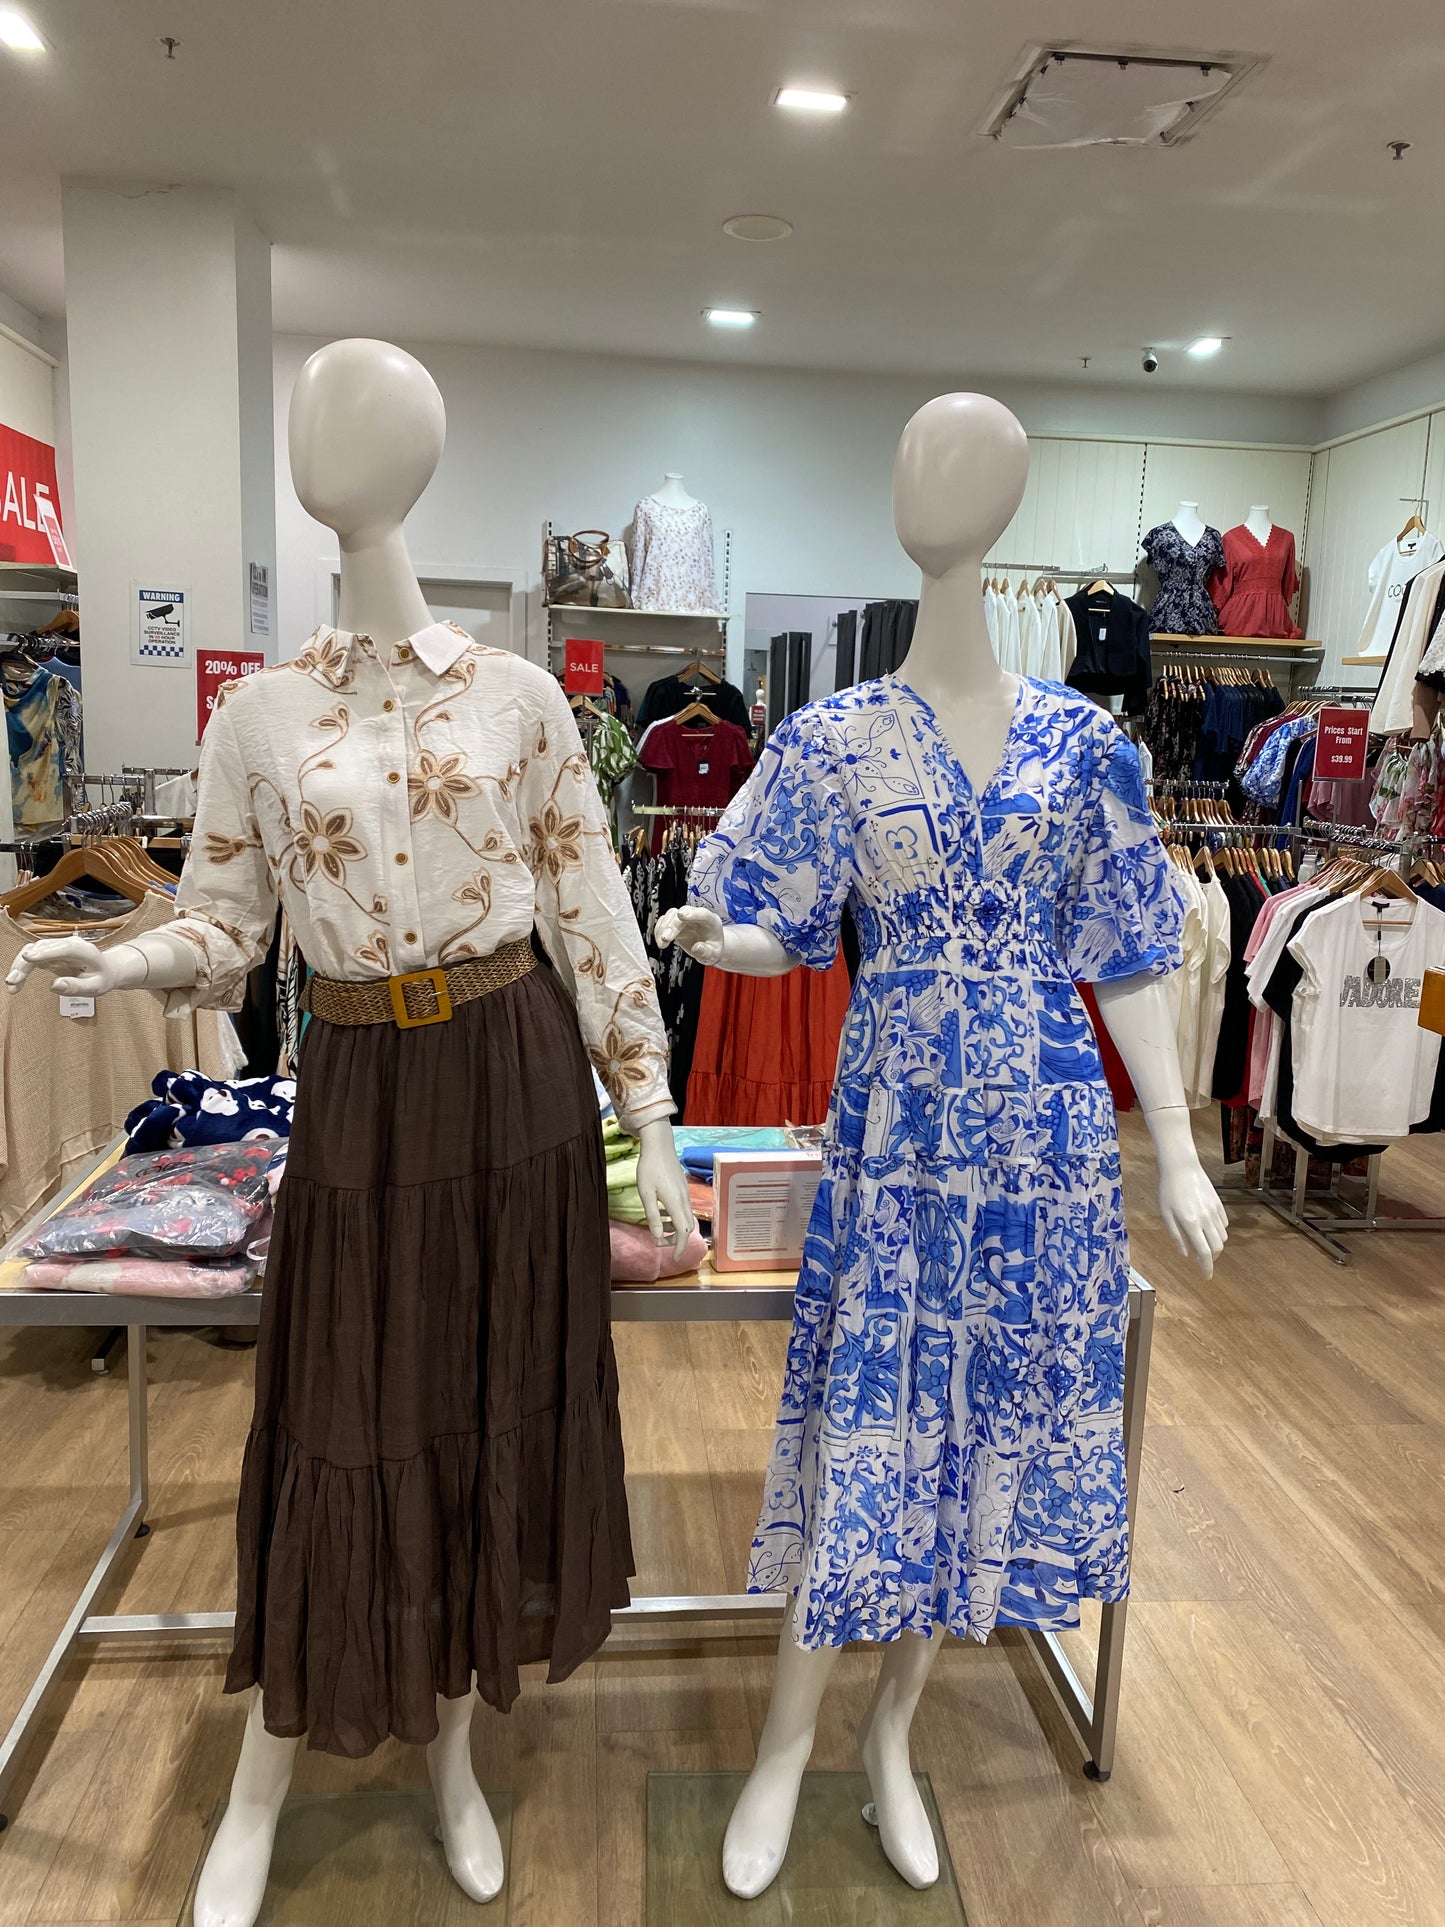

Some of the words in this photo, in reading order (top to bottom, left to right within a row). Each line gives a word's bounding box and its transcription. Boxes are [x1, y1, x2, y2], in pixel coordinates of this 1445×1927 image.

[0, 471, 50, 533] ALE
[143, 591, 180, 602] WARNING
[205, 660, 237, 675] 20%
[241, 662, 261, 676] OFF
[570, 662, 599, 673] SALE
[1324, 726, 1345, 735] Prices
[1348, 727, 1363, 736] Start
[1336, 736, 1352, 744] From
[1331, 755, 1353, 764] $39.99
